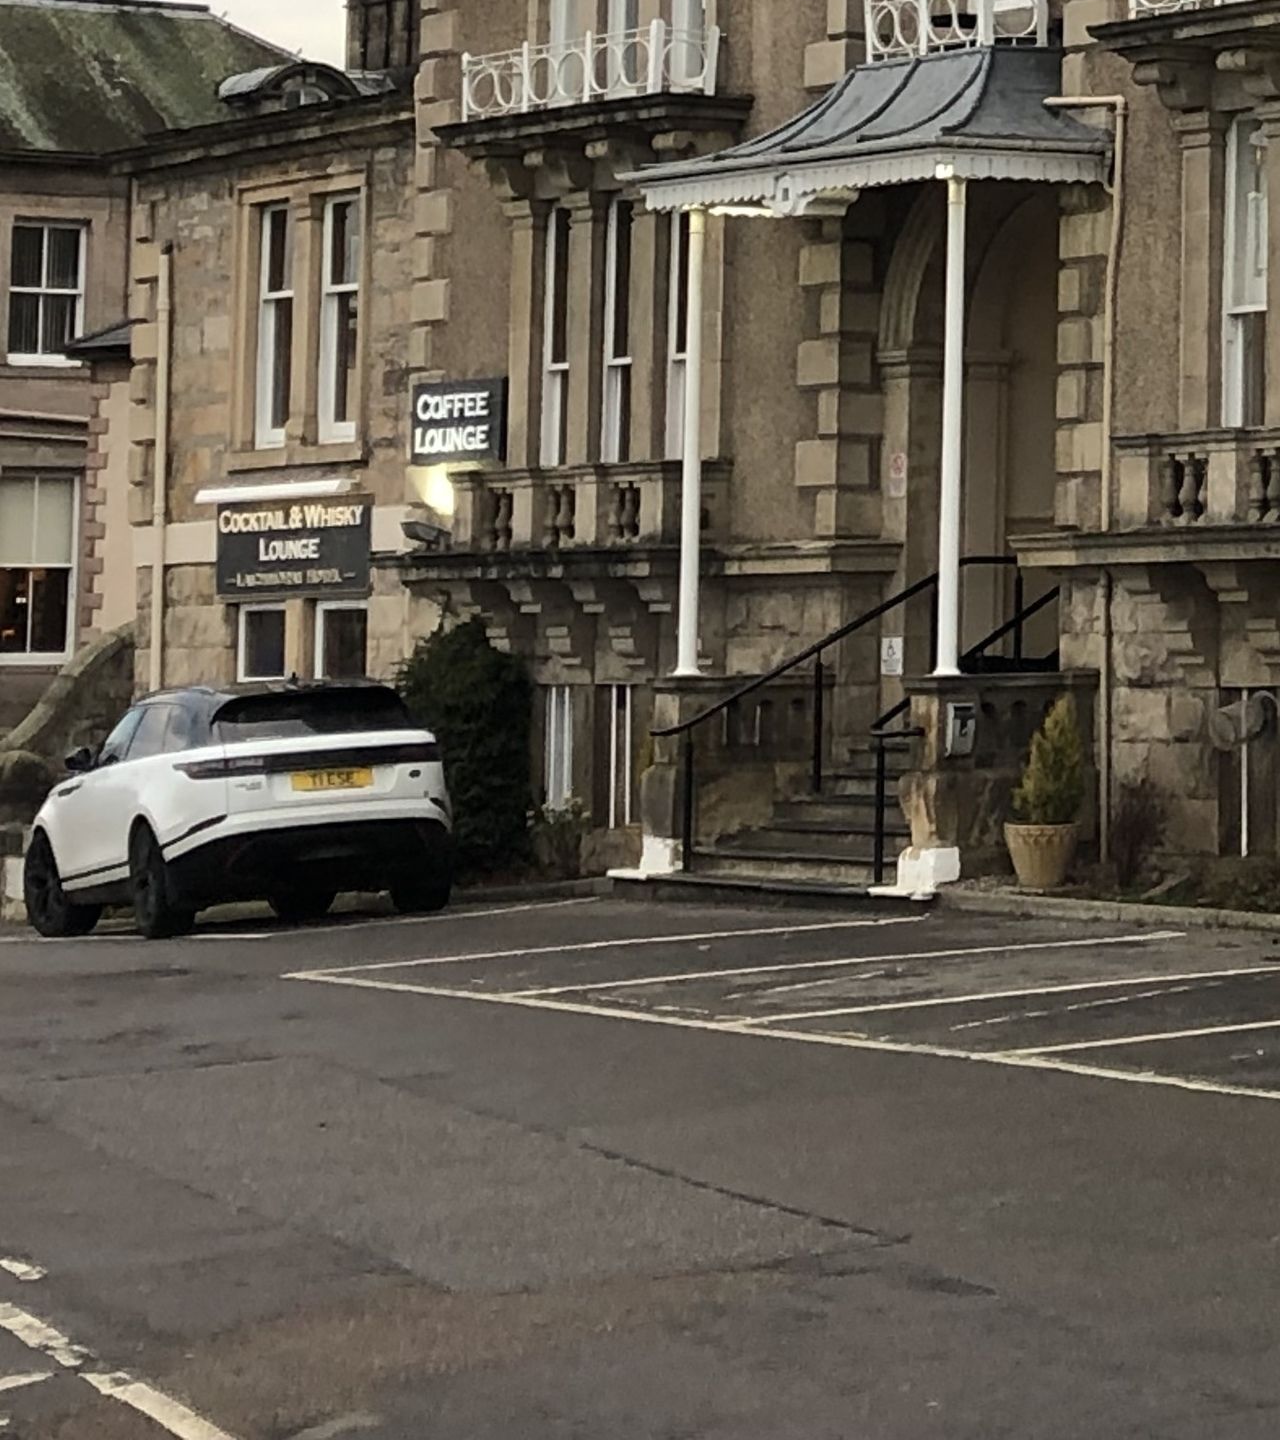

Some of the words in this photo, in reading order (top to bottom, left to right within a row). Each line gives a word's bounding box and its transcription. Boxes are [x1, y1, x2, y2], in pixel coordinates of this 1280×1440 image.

[417, 391, 489, 421] COFFEE
[414, 424, 489, 453] LOUNGE
[219, 509, 288, 533] COCKTAIL
[289, 505, 302, 528] &
[303, 504, 364, 529] WHISKY
[258, 537, 320, 561] LOUNGE
